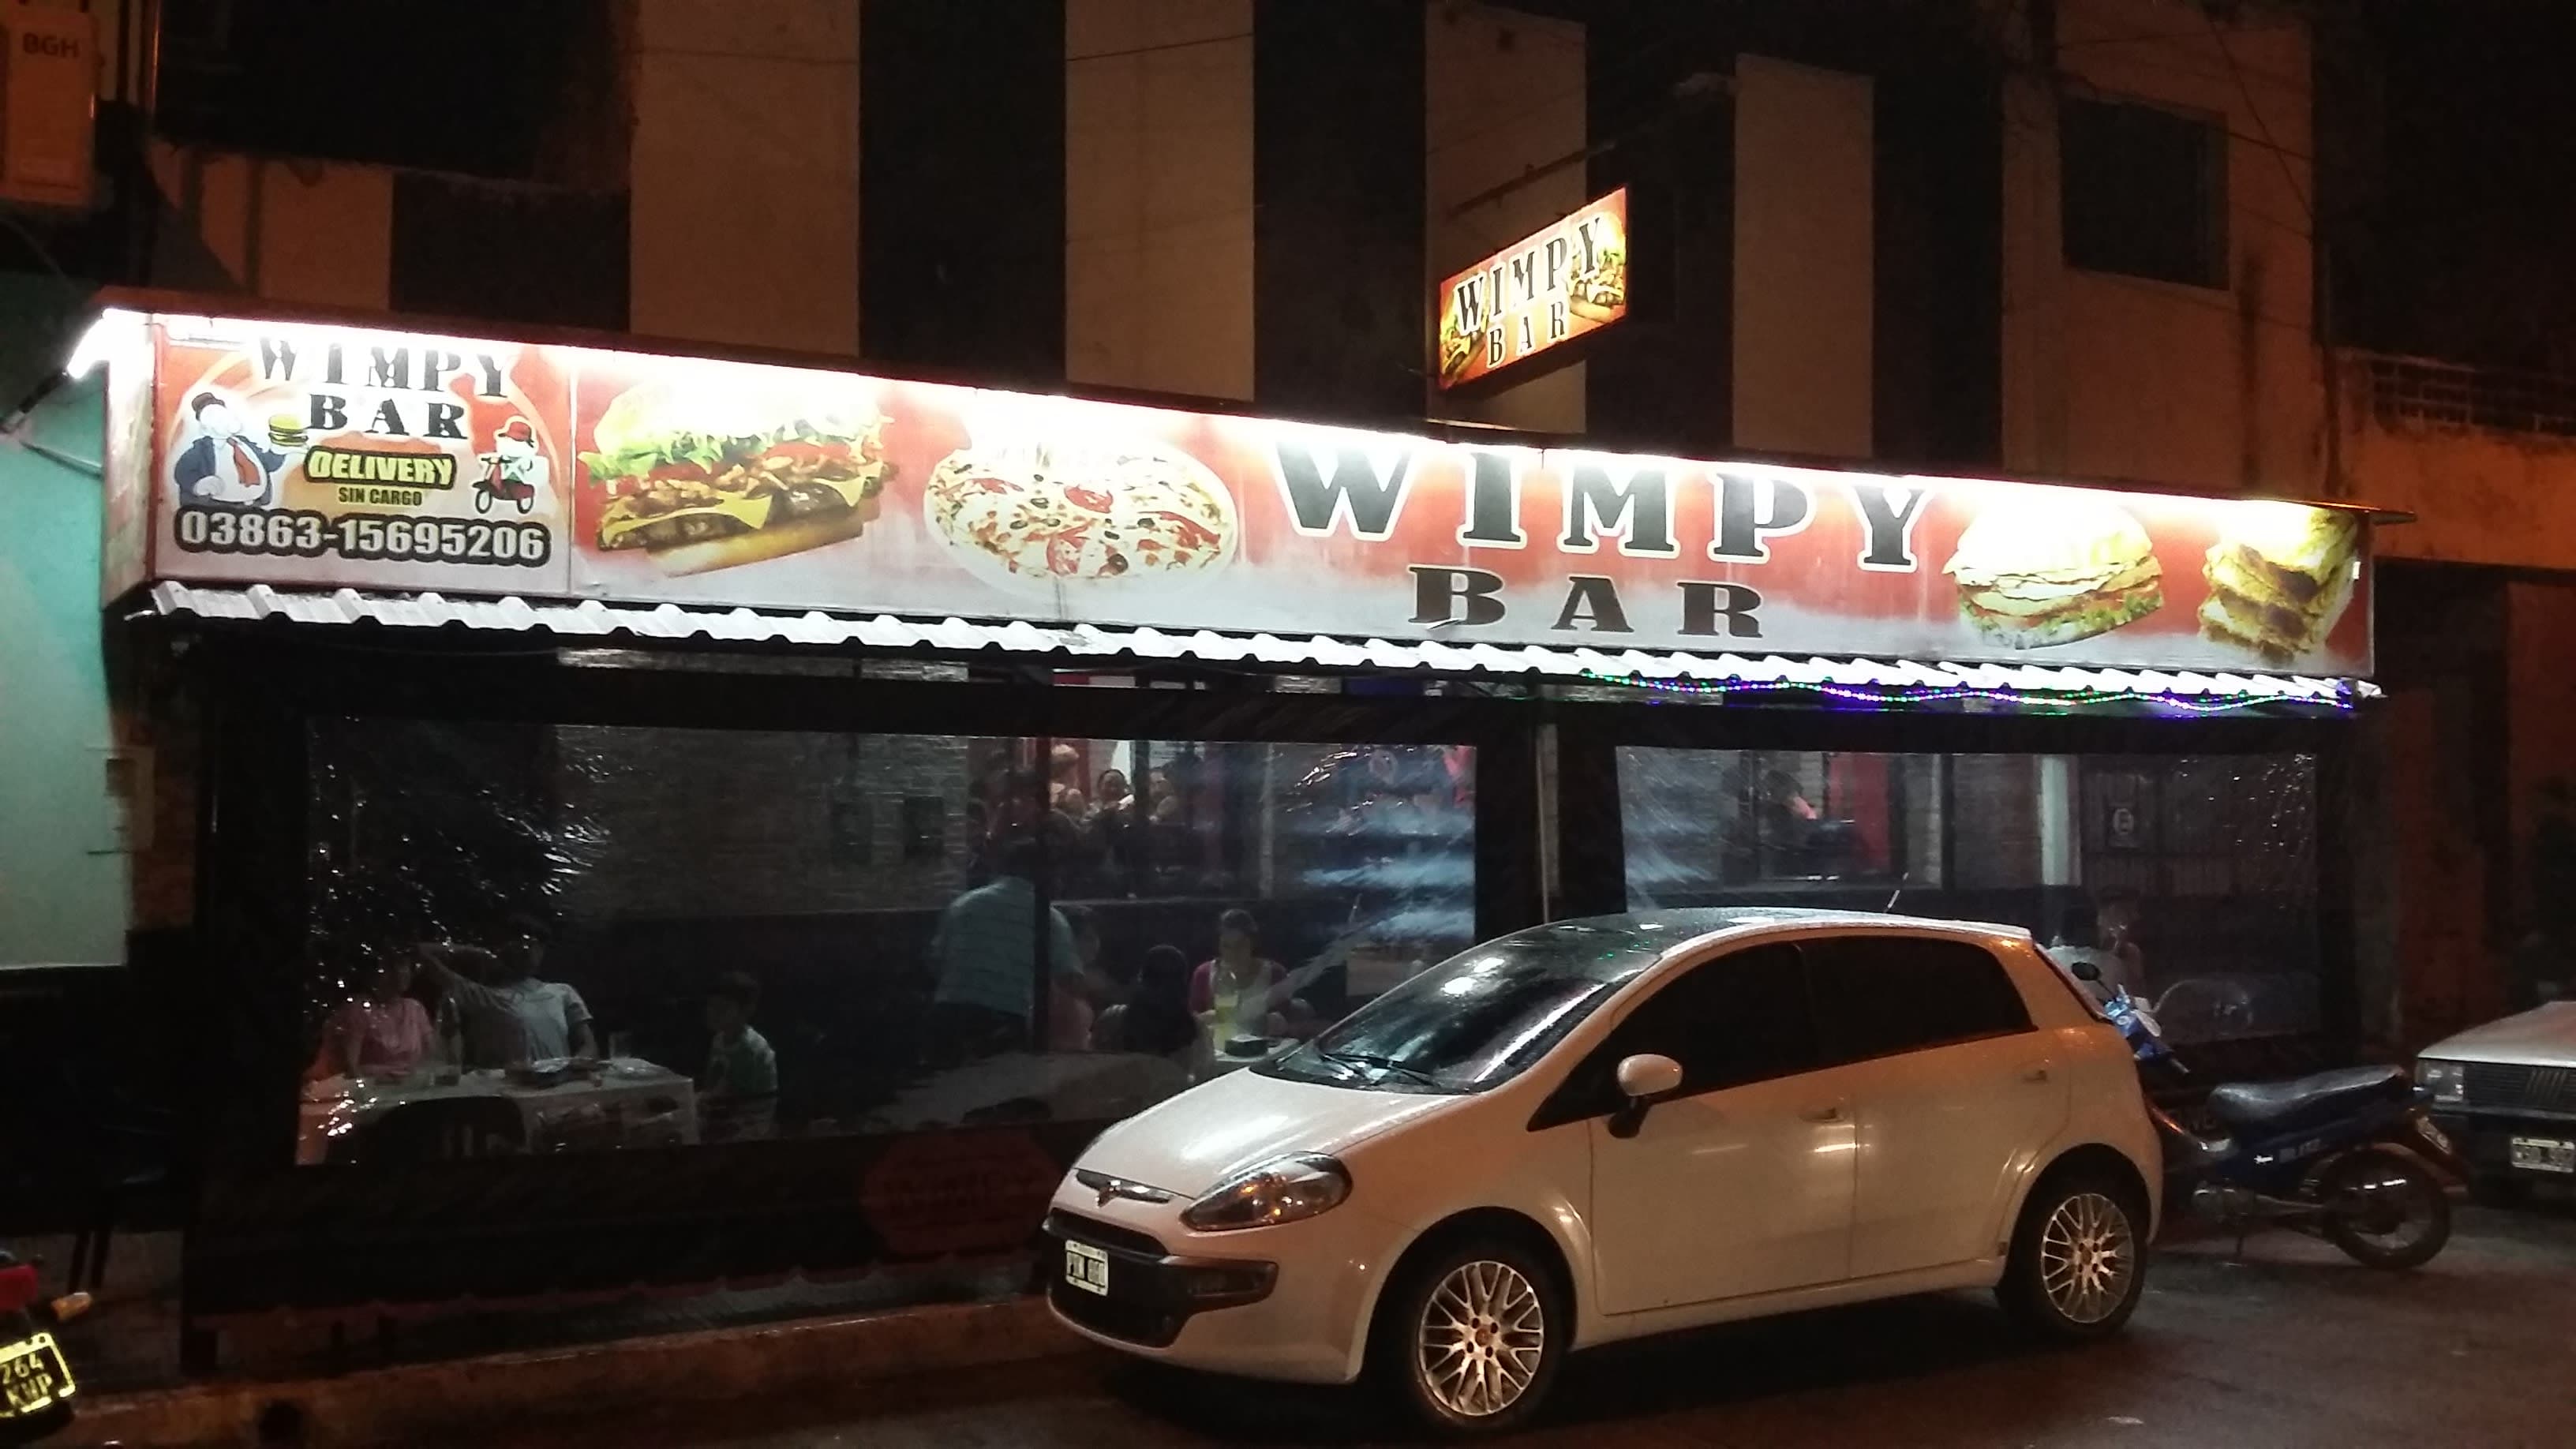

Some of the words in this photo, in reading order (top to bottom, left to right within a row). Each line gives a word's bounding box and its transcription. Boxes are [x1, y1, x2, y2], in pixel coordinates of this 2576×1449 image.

[23, 32, 80, 58] BGH
[1457, 217, 1601, 330] WIMPY
[1488, 301, 1565, 365] BAR
[259, 336, 508, 397] WIMPY
[306, 393, 469, 440] BAR
[307, 447, 454, 487] DELIVERY
[339, 487, 368, 504] SIN
[370, 488, 423, 507] CARGO
[1274, 439, 1927, 565] WIMPY
[180, 511, 545, 560] 03863-15695206
[1408, 566, 1763, 638] BAR
